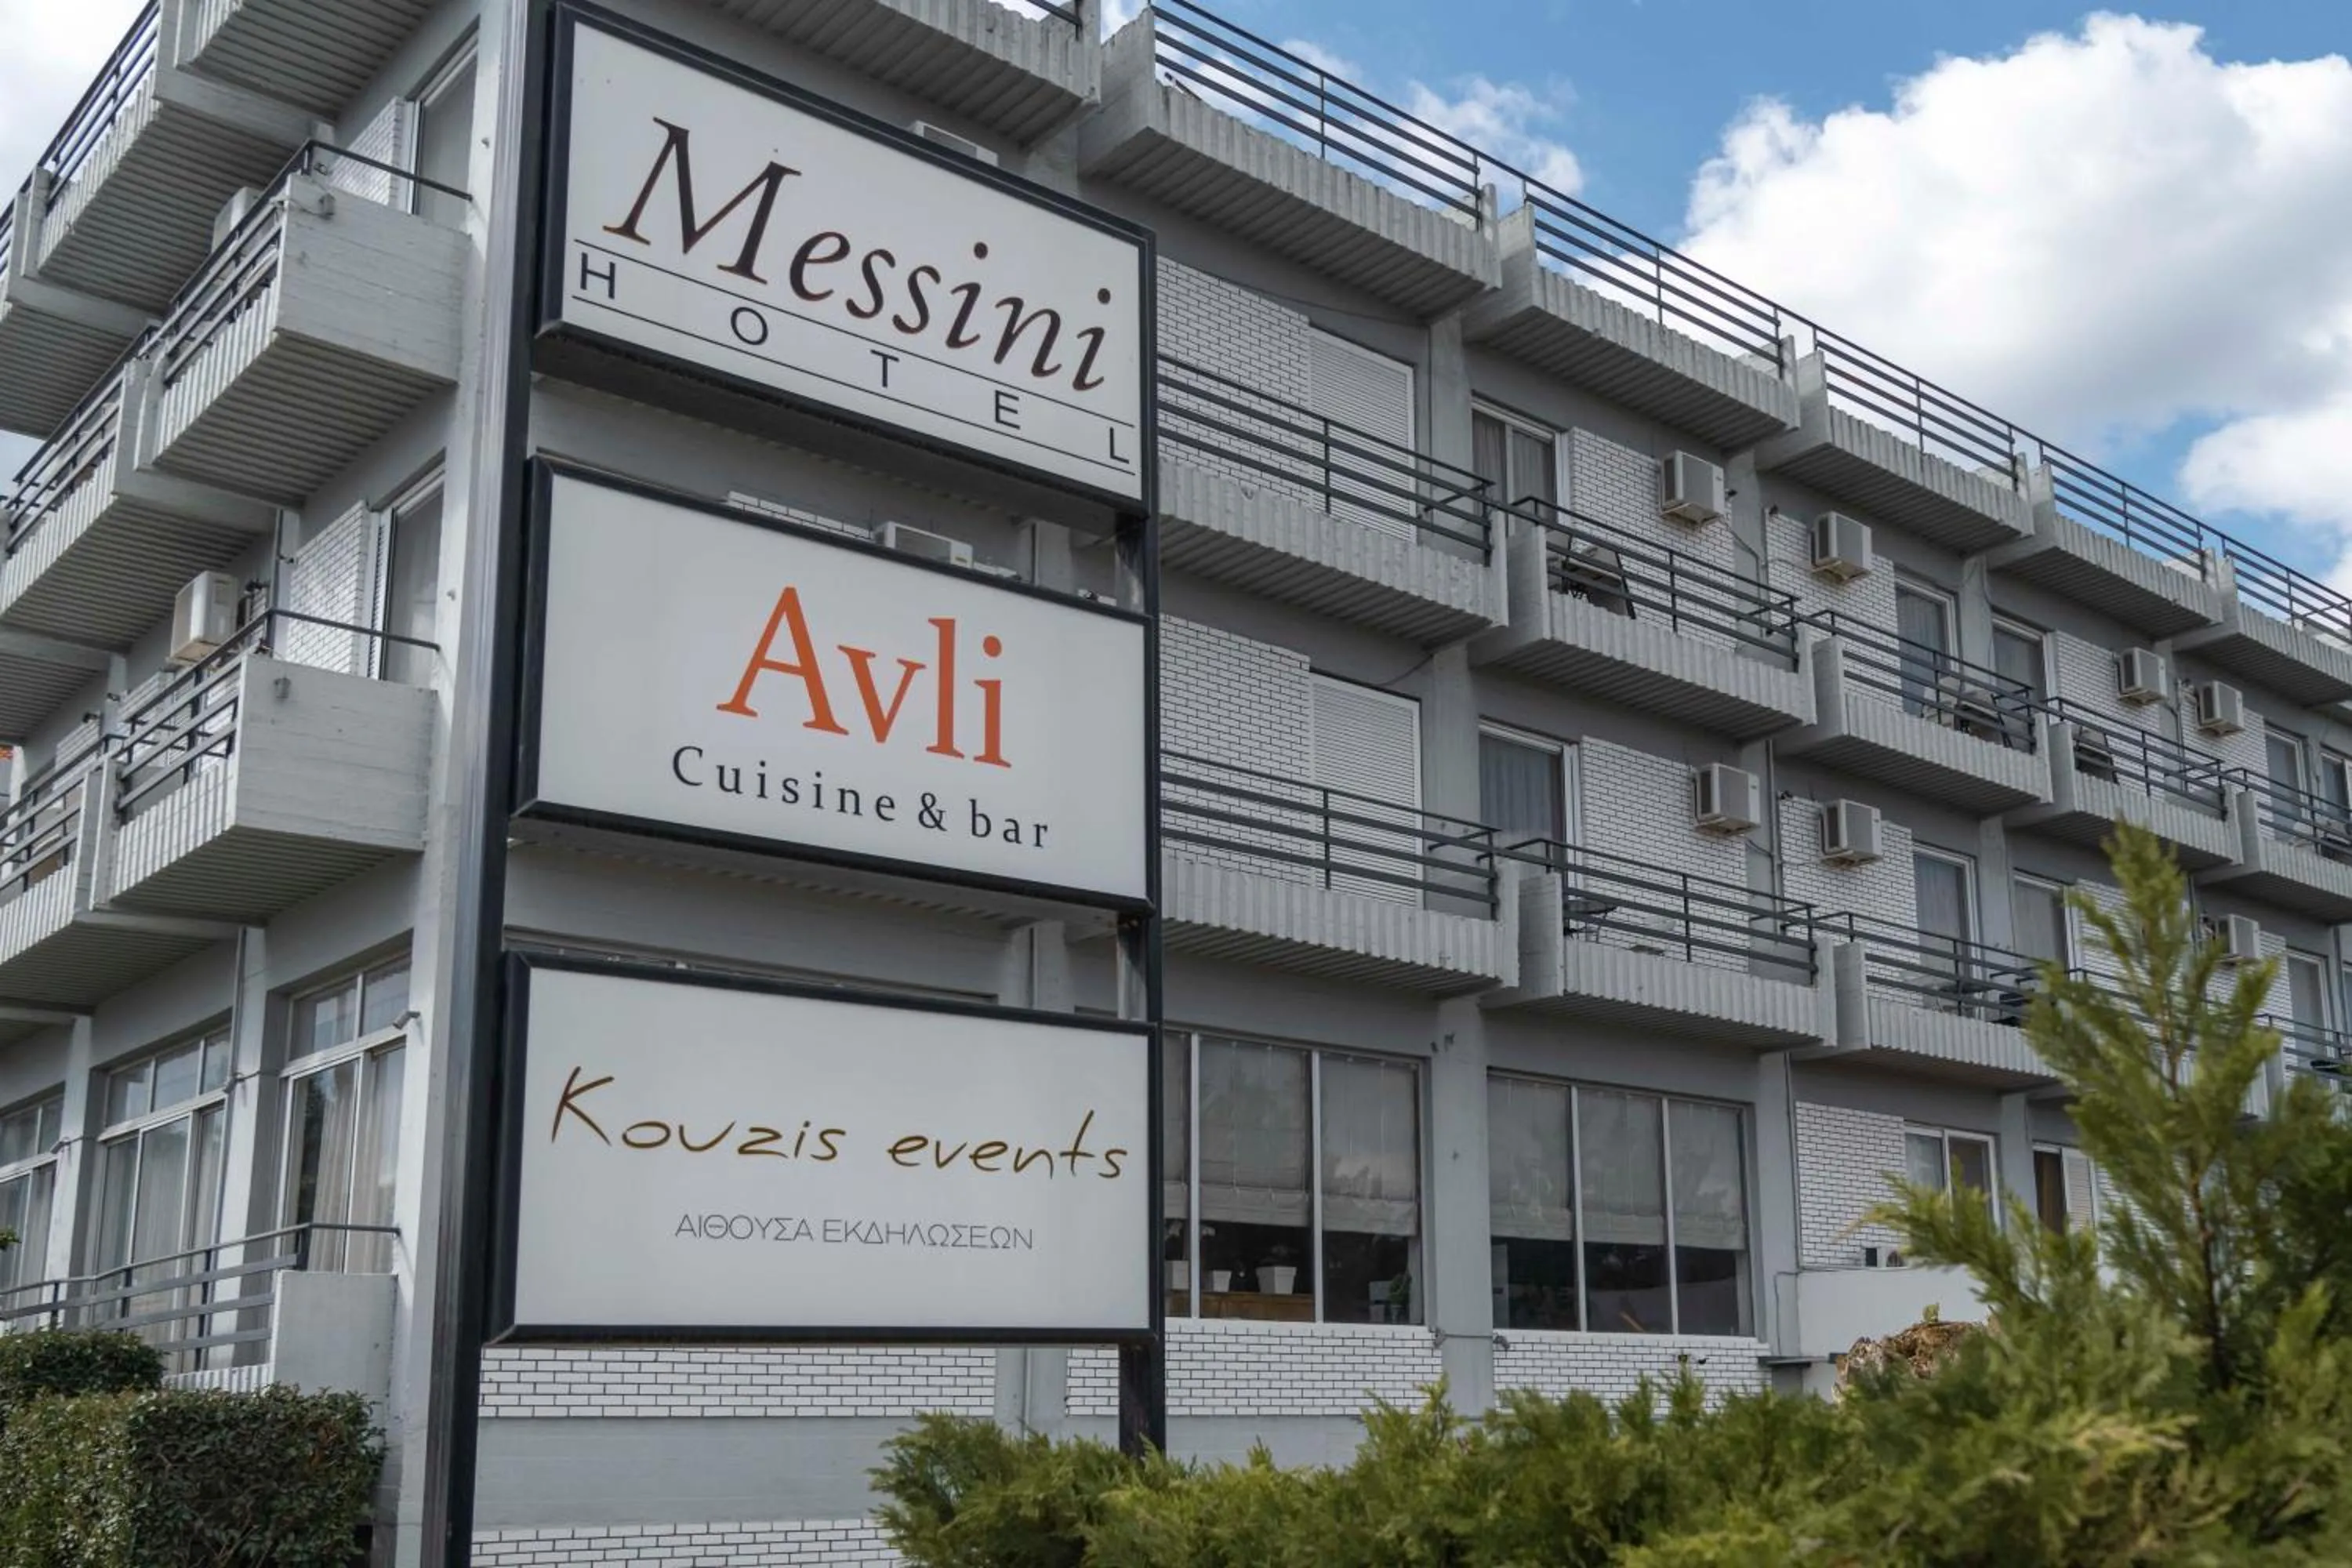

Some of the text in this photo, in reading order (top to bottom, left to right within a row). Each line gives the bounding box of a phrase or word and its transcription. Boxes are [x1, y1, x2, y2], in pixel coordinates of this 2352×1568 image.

[602, 117, 1112, 392] Messini
[579, 252, 1130, 464] HOTEL
[717, 586, 1012, 769] Avli
[672, 745, 1048, 850] Cuisine & bar
[551, 1065, 1128, 1180] Kouzis events
[674, 1214, 1033, 1250] ΑΙΘΟΥΣΑ ΕΚΔΗΛΩΣΕΩΝ
